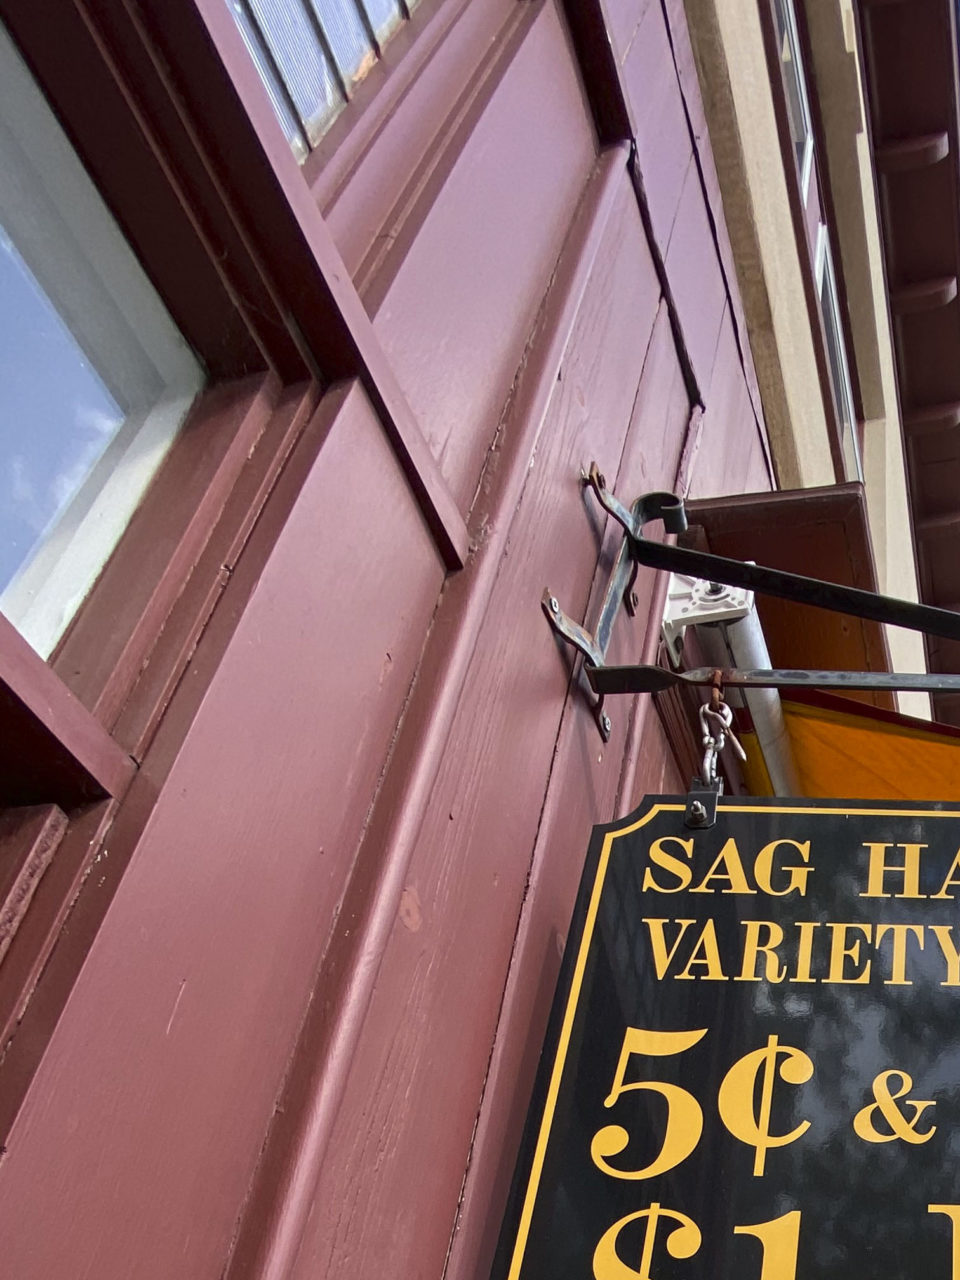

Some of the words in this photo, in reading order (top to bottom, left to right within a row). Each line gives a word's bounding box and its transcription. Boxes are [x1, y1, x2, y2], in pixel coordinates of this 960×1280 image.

[641, 836, 814, 897] SAG
[589, 1026, 815, 1181] 5¢
[852, 1068, 938, 1146] &
